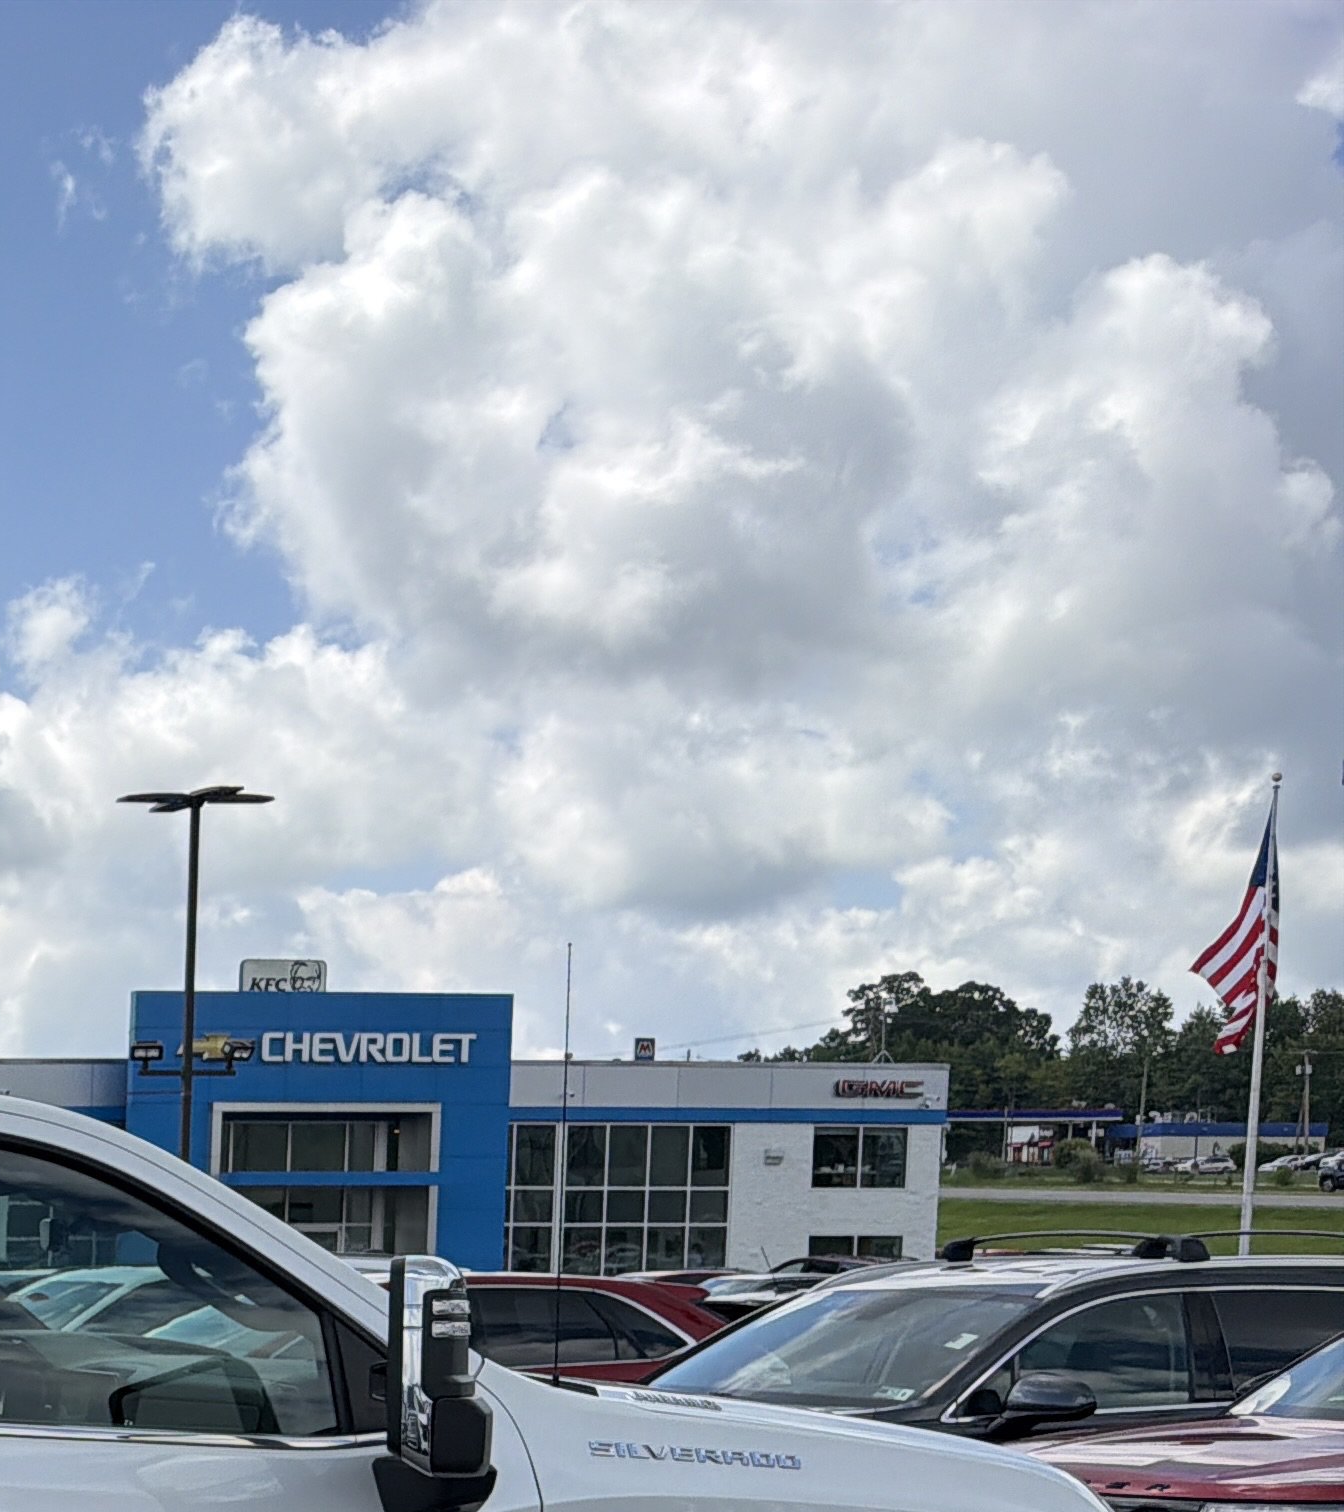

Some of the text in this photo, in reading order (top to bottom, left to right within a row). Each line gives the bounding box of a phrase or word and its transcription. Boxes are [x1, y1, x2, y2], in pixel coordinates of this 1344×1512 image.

[249, 977, 288, 992] KFC
[262, 1031, 477, 1063] CHEVROLET
[833, 1079, 924, 1099] GMC
[589, 1440, 802, 1470] SILVERADO
